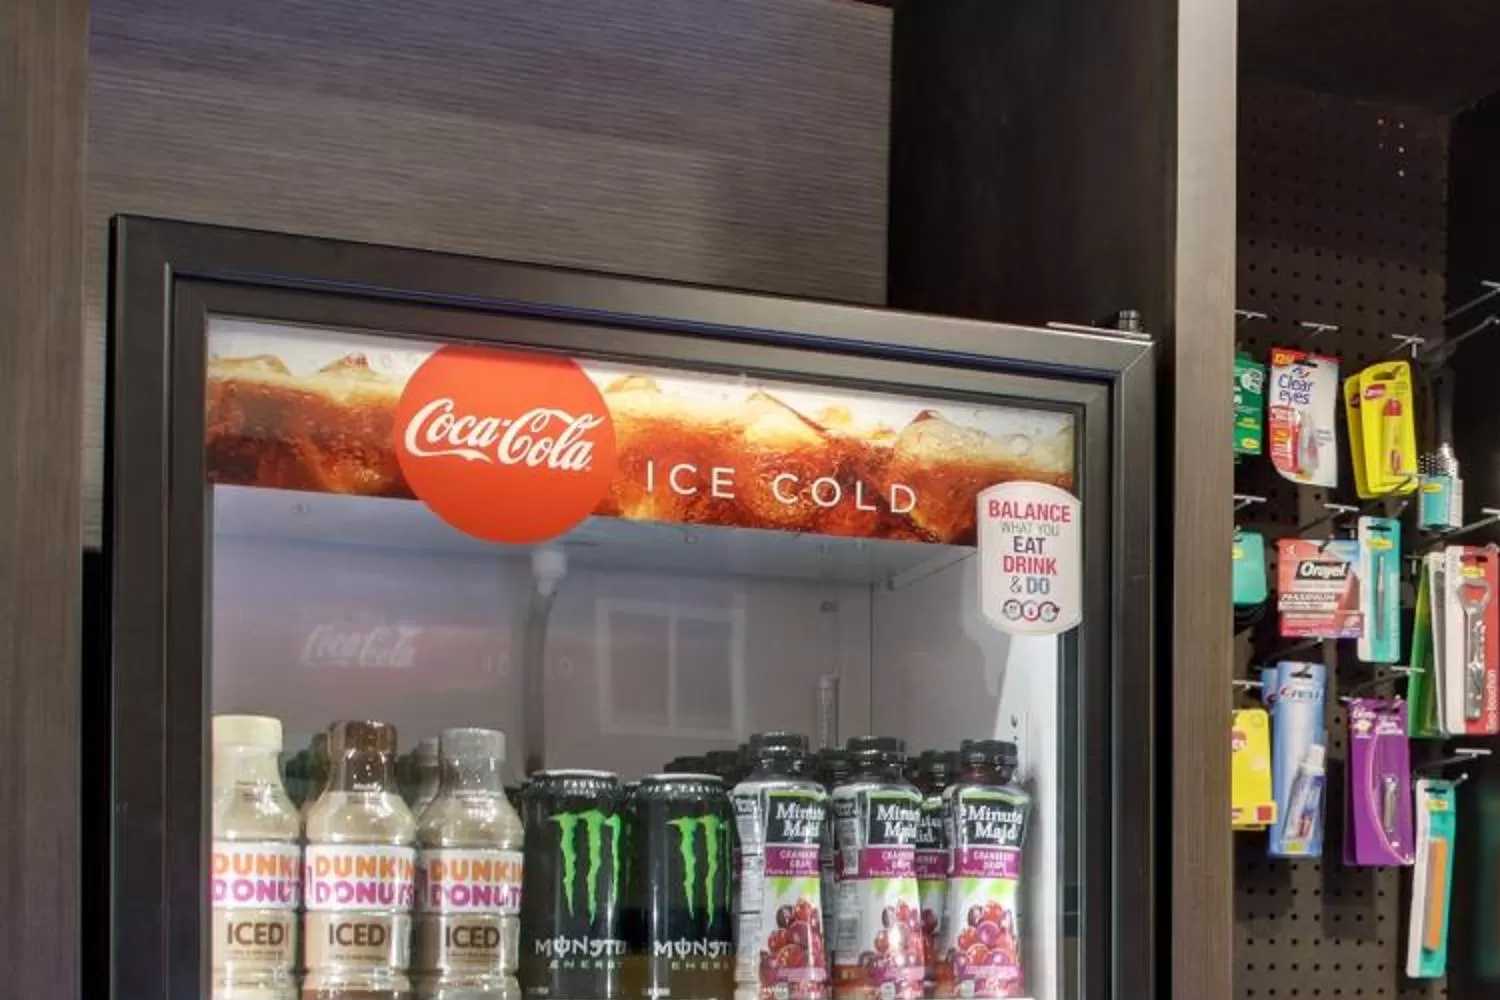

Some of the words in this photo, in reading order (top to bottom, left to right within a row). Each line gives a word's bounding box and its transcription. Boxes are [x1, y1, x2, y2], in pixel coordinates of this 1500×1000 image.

[1279, 374, 1314, 393] Clear
[1279, 390, 1310, 406] eyes
[404, 398, 605, 472] Coca-Cola
[645, 460, 736, 500] ICE
[772, 472, 917, 514] COLD
[988, 500, 1071, 522] BALANCE
[1001, 522, 1031, 533] WHAT
[1038, 523, 1059, 536] YOU
[1013, 536, 1045, 554] EAT
[1003, 555, 1057, 575] DRINK
[1009, 576, 1022, 593] &
[1026, 577, 1050, 595] DO
[967, 805, 1023, 824] Minute
[973, 821, 1018, 840] Maid
[227, 922, 284, 945] ICED
[329, 923, 385, 946] ICED
[446, 926, 500, 948] ICED
